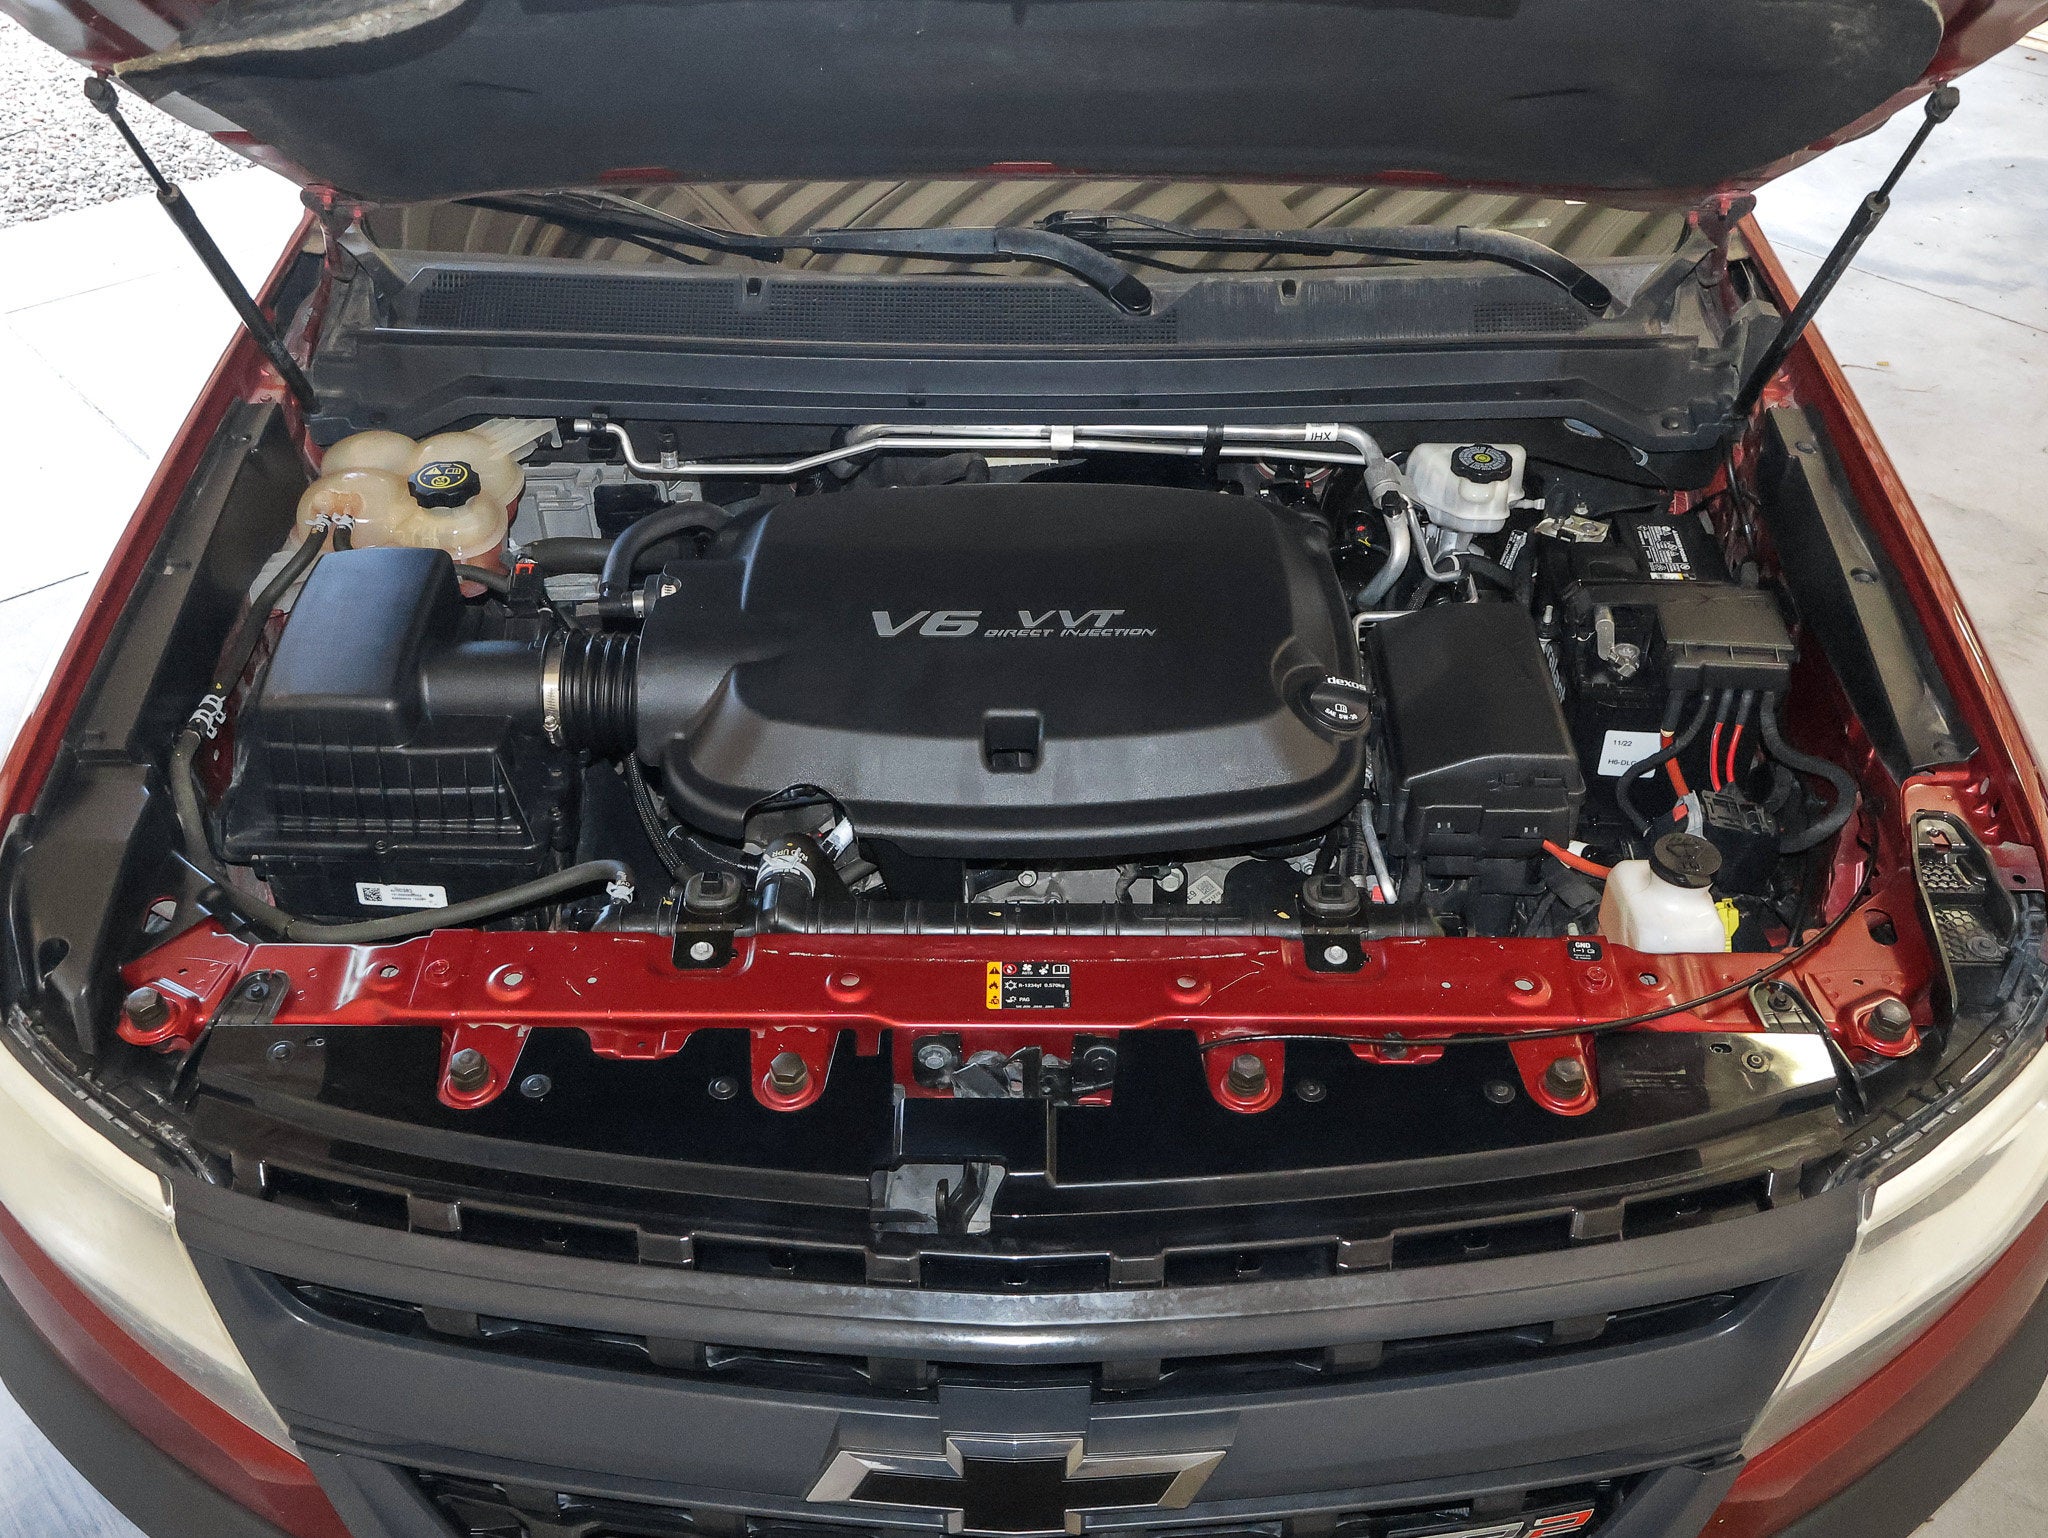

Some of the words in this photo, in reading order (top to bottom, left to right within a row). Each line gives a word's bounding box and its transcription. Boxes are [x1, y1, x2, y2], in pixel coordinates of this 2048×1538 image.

[872, 610, 982, 637] V6
[1018, 609, 1125, 628] VVT
[984, 629, 1054, 638] DIRECT
[1060, 628, 1157, 637] INJECTION
[1327, 676, 1367, 691] dexos
[1574, 941, 1591, 949] GND
